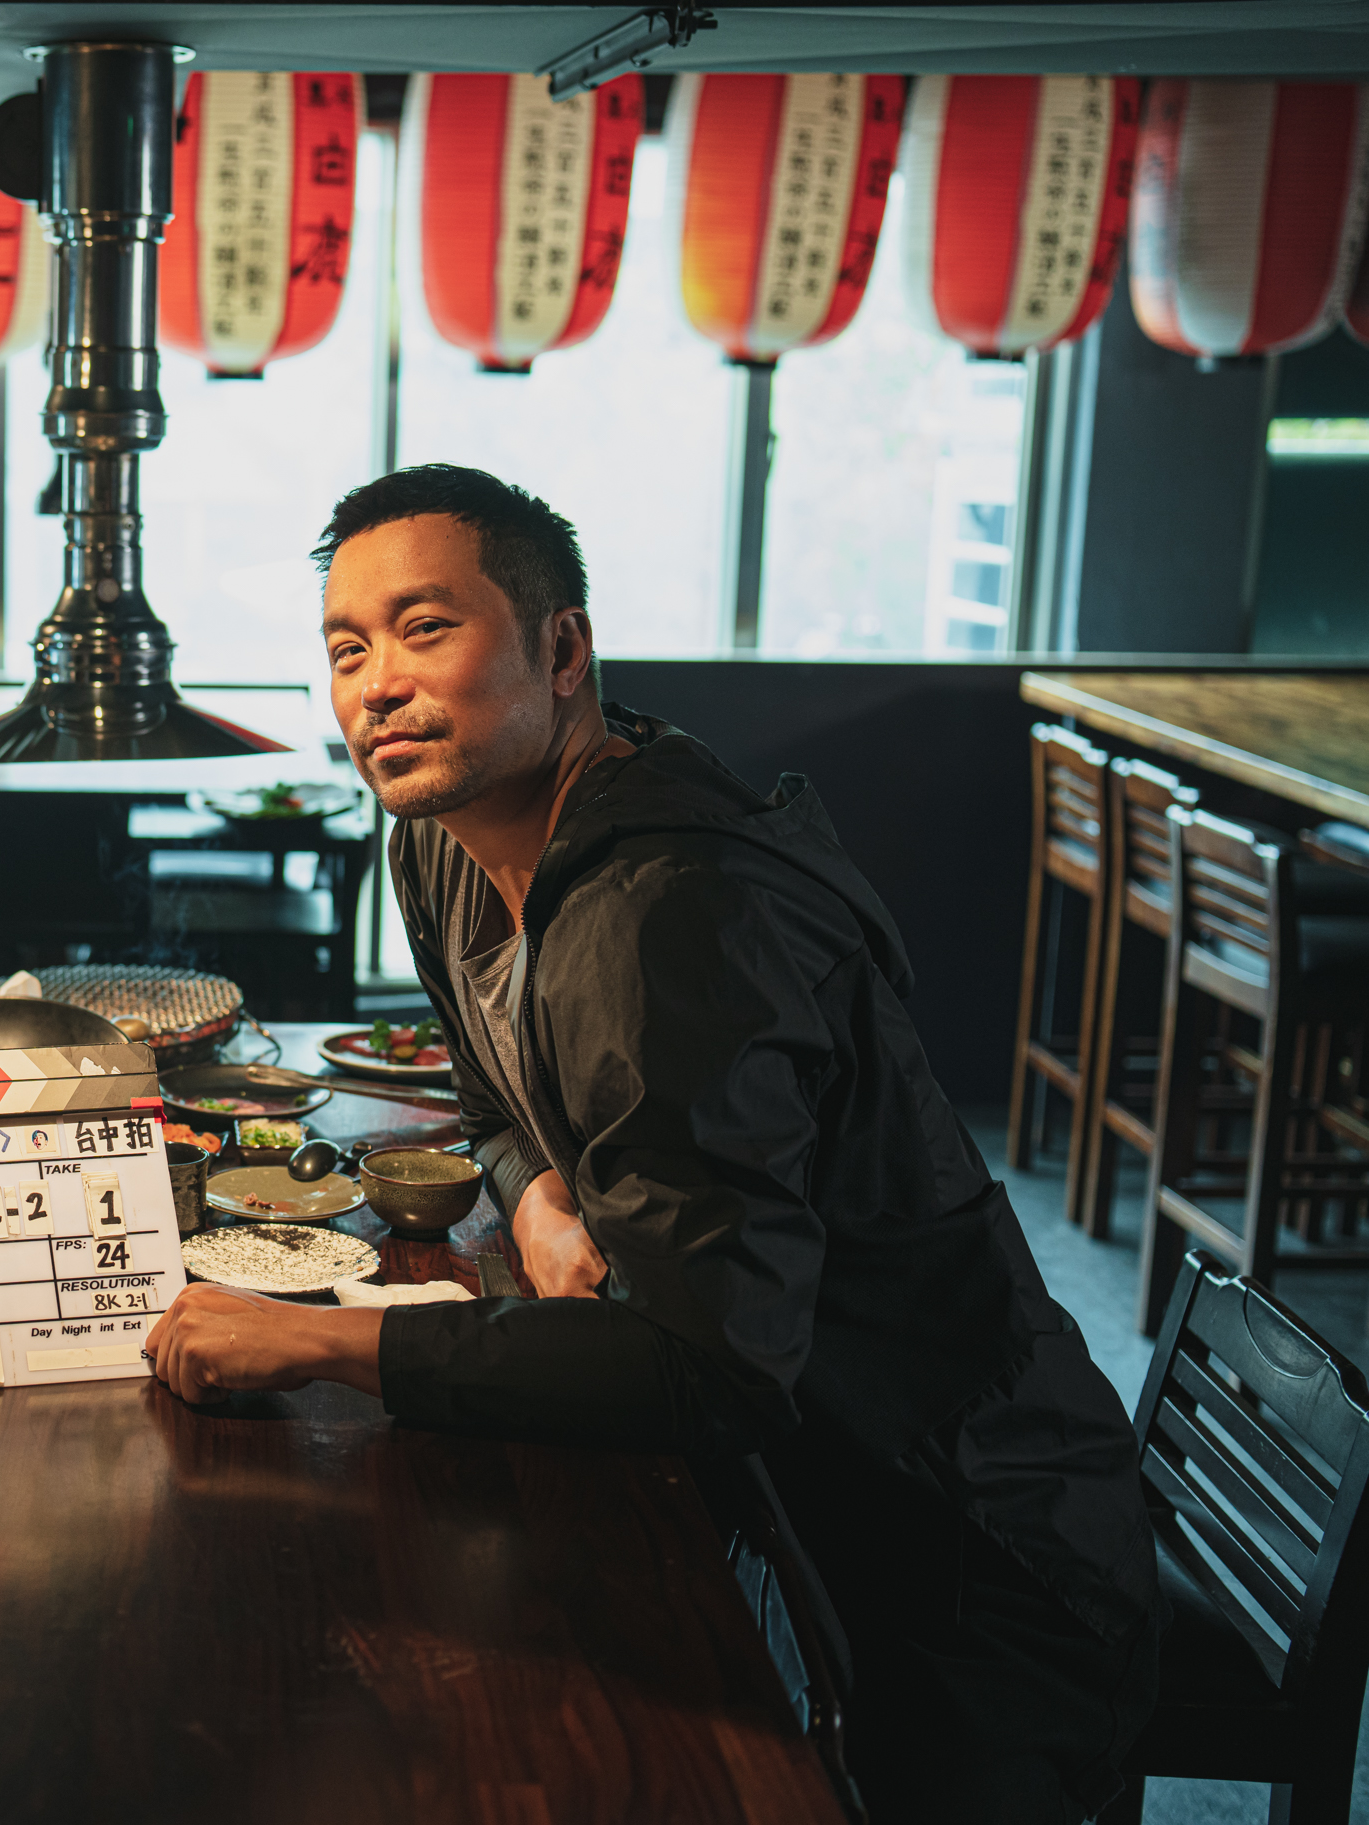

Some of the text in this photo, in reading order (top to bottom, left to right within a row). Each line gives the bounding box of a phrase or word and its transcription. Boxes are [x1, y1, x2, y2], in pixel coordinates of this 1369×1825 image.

[75, 1117, 154, 1154] 台中拍
[43, 1163, 82, 1175] TAKE
[99, 1190, 122, 1226] 1
[55, 1240, 87, 1251] FPS:
[96, 1241, 130, 1270] 24
[60, 1276, 156, 1293] RESOLUTION:
[94, 1293, 121, 1311] 8K
[31, 1320, 142, 1338] Day Night int Ext
